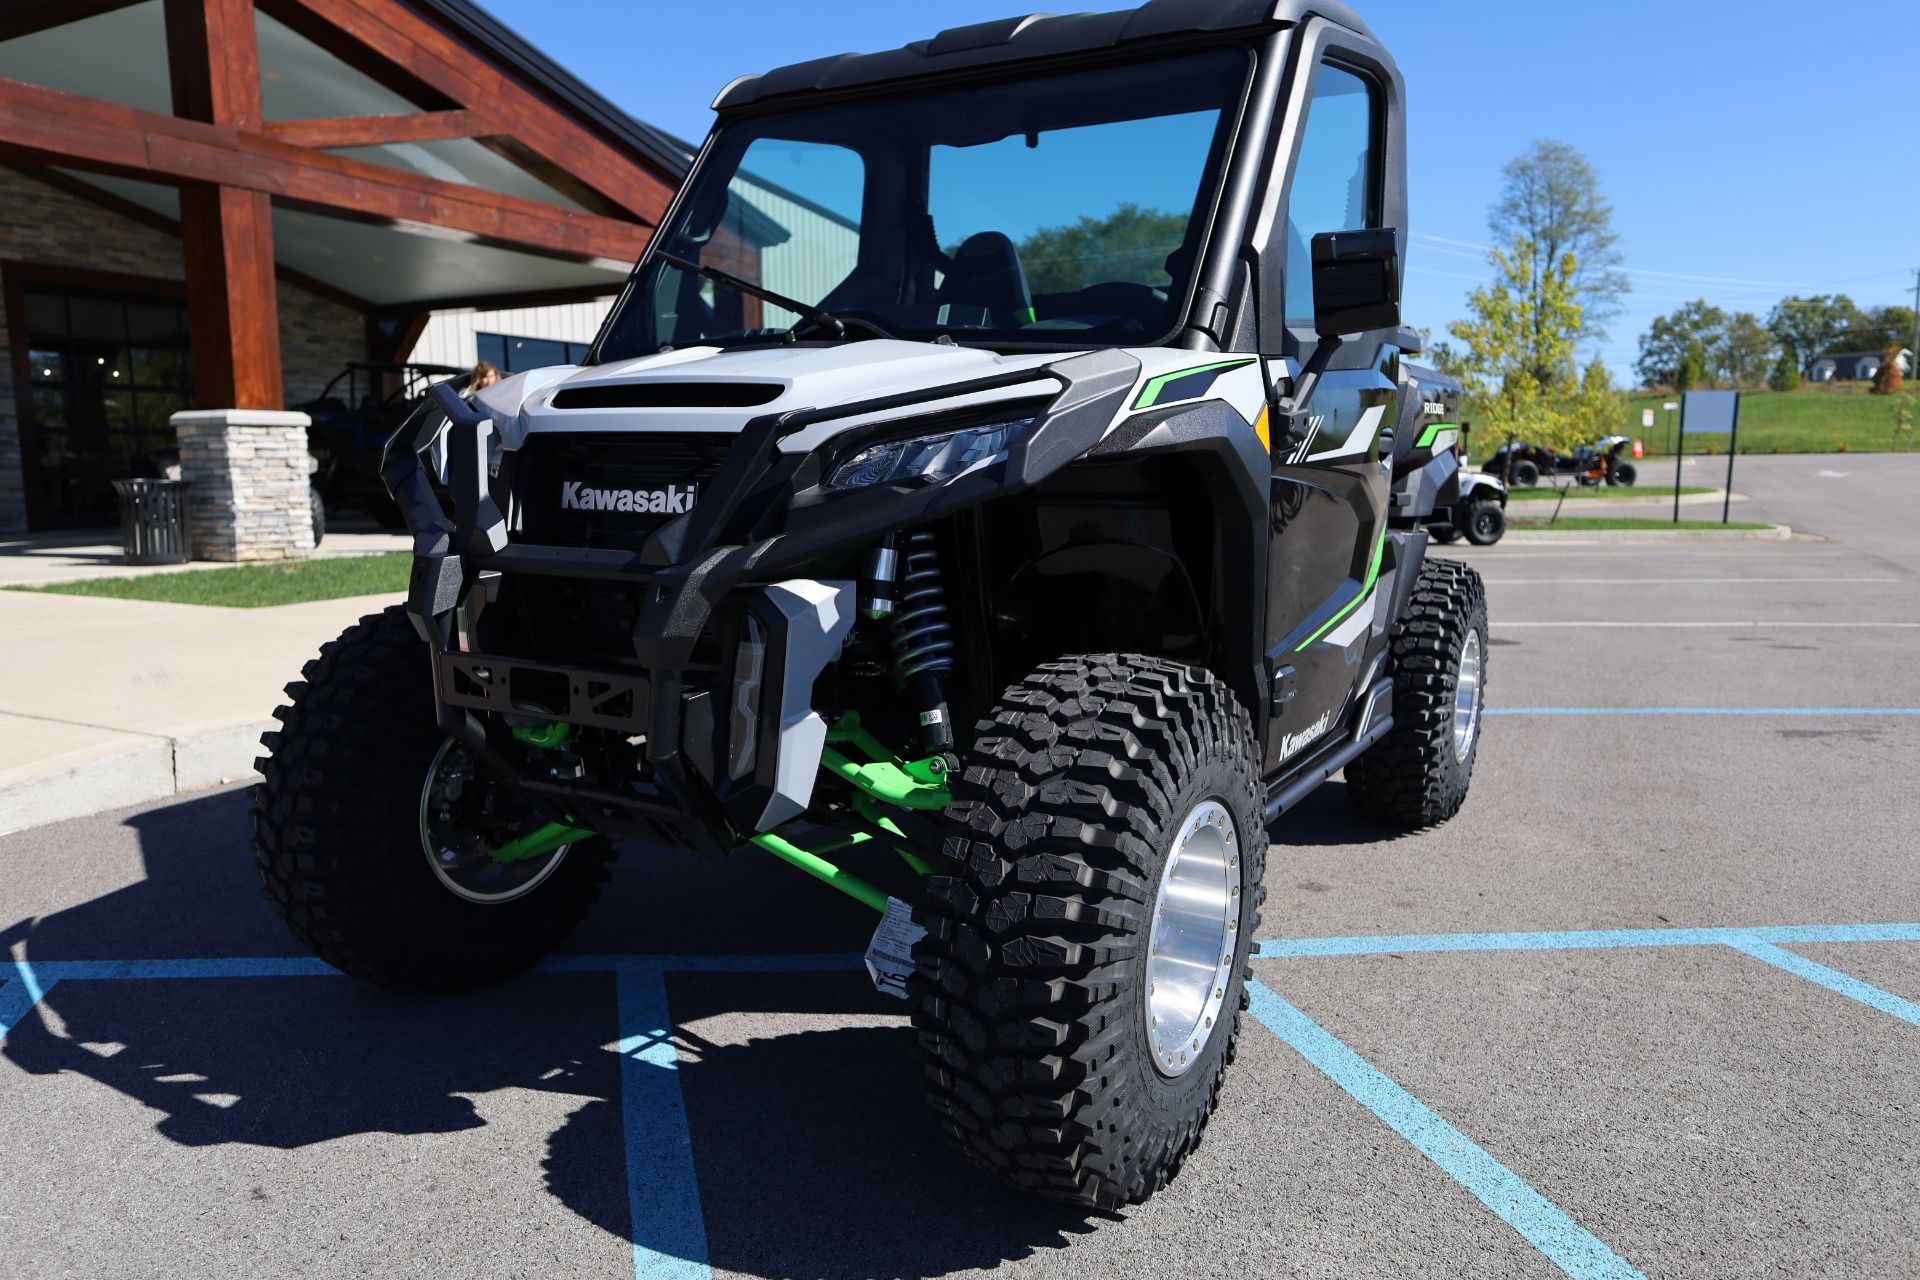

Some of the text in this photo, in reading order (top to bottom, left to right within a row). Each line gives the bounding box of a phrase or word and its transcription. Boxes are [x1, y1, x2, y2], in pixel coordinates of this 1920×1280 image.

[1424, 402, 1445, 415] RIDGE
[561, 481, 695, 514] Kawasaki
[1279, 709, 1331, 762] Kawasaki
